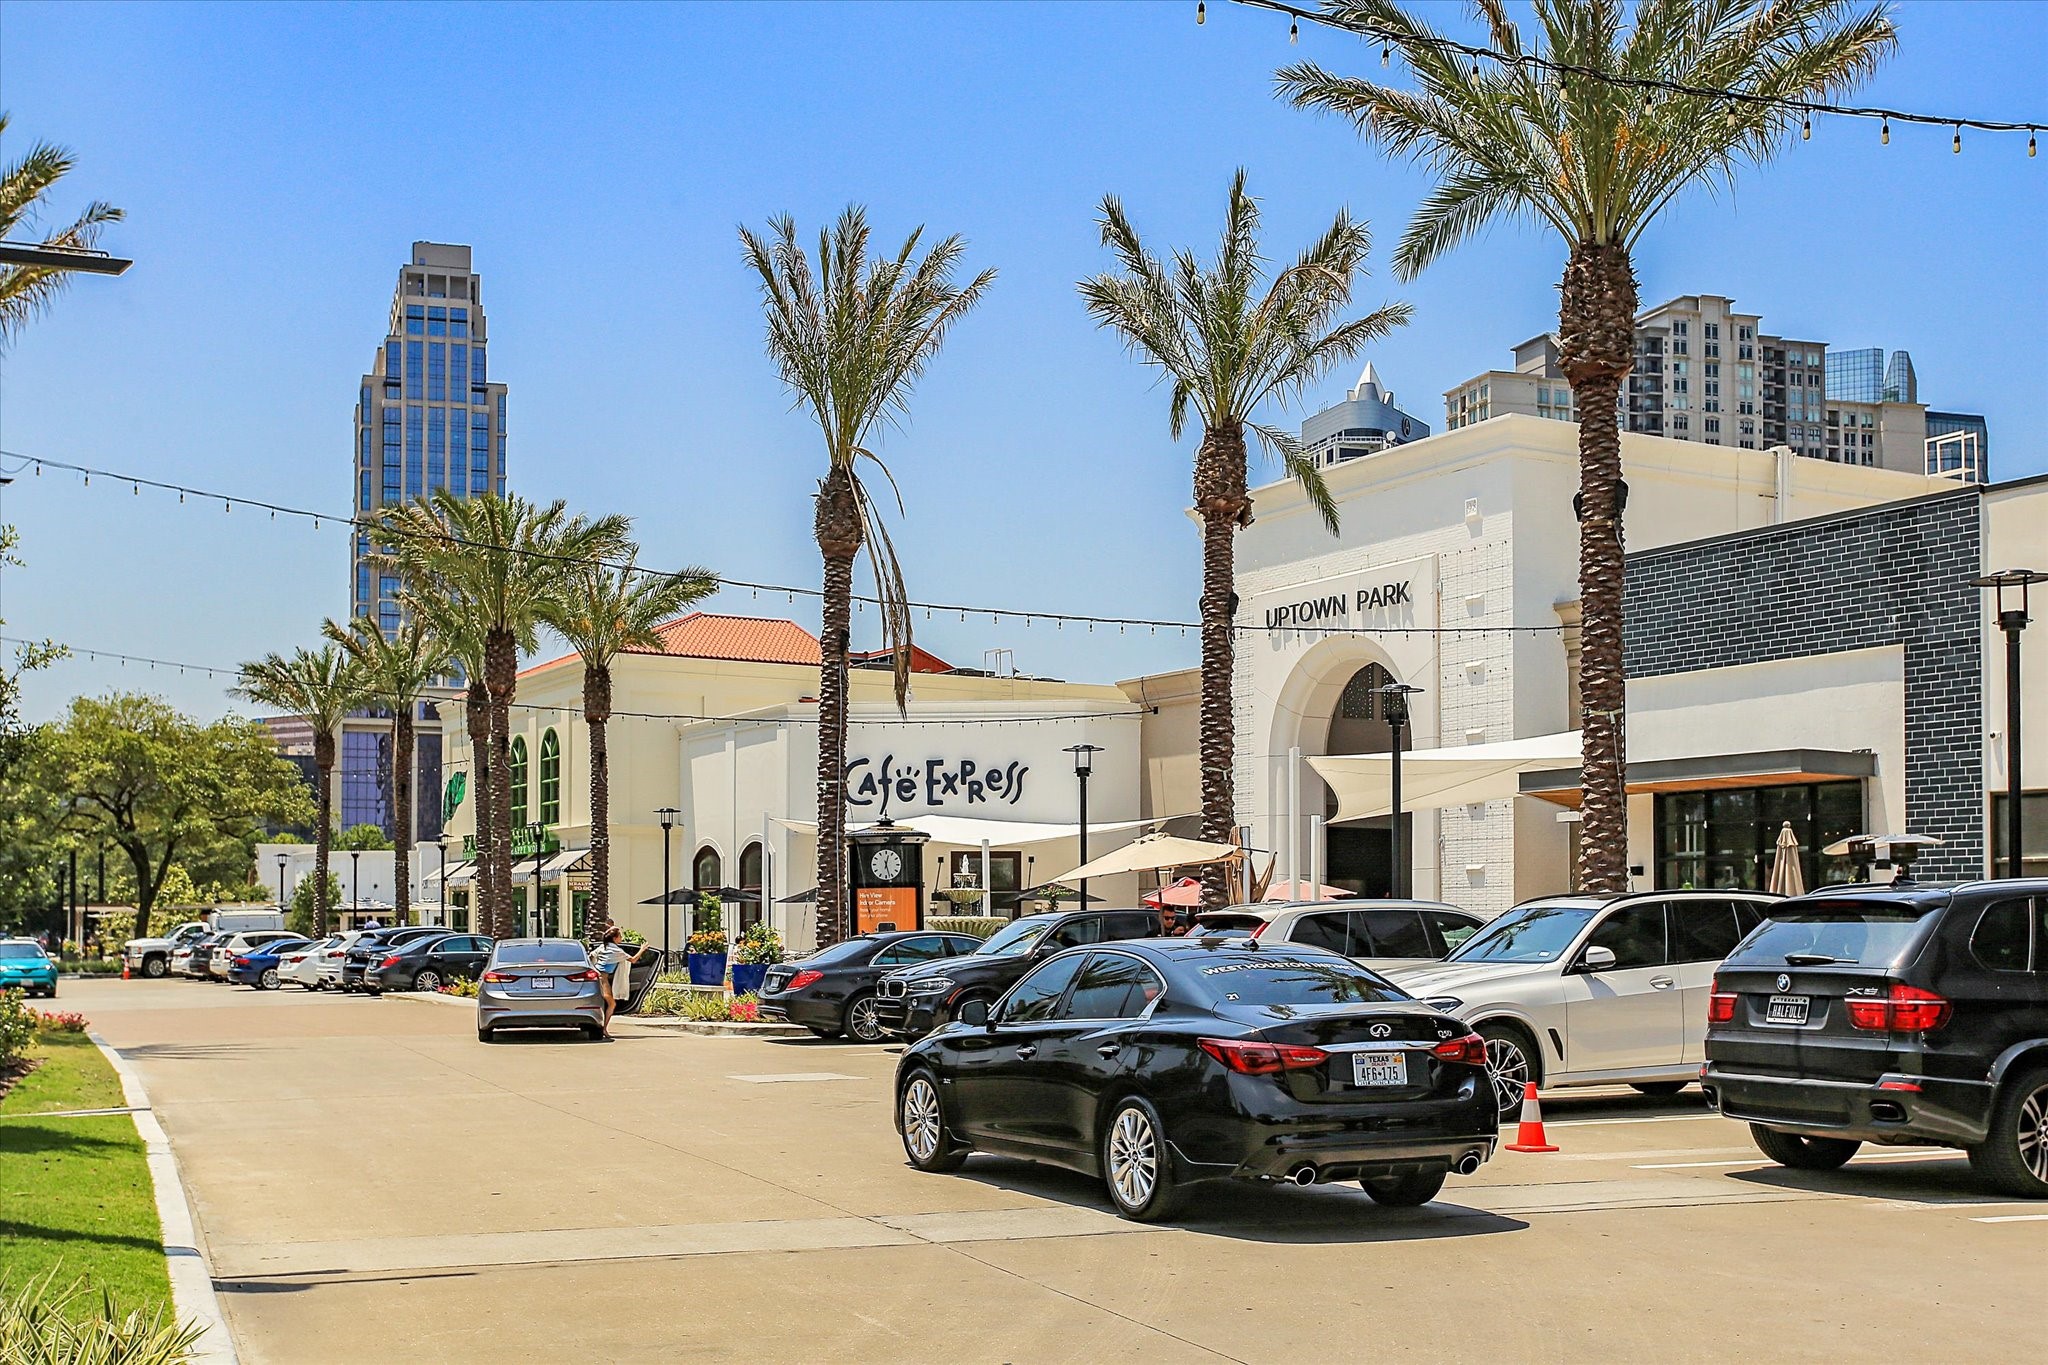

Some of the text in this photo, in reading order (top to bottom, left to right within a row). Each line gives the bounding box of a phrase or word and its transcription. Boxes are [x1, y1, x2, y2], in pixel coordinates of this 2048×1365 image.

[1266, 580, 1410, 628] UPTOWN PARK
[1203, 964, 1243, 975] WEST
[1244, 962, 1312, 970] HOUSTON
[1846, 987, 1878, 995] X5
[1772, 1004, 1802, 1018] HALFULL
[1437, 1030, 1452, 1038] Q50
